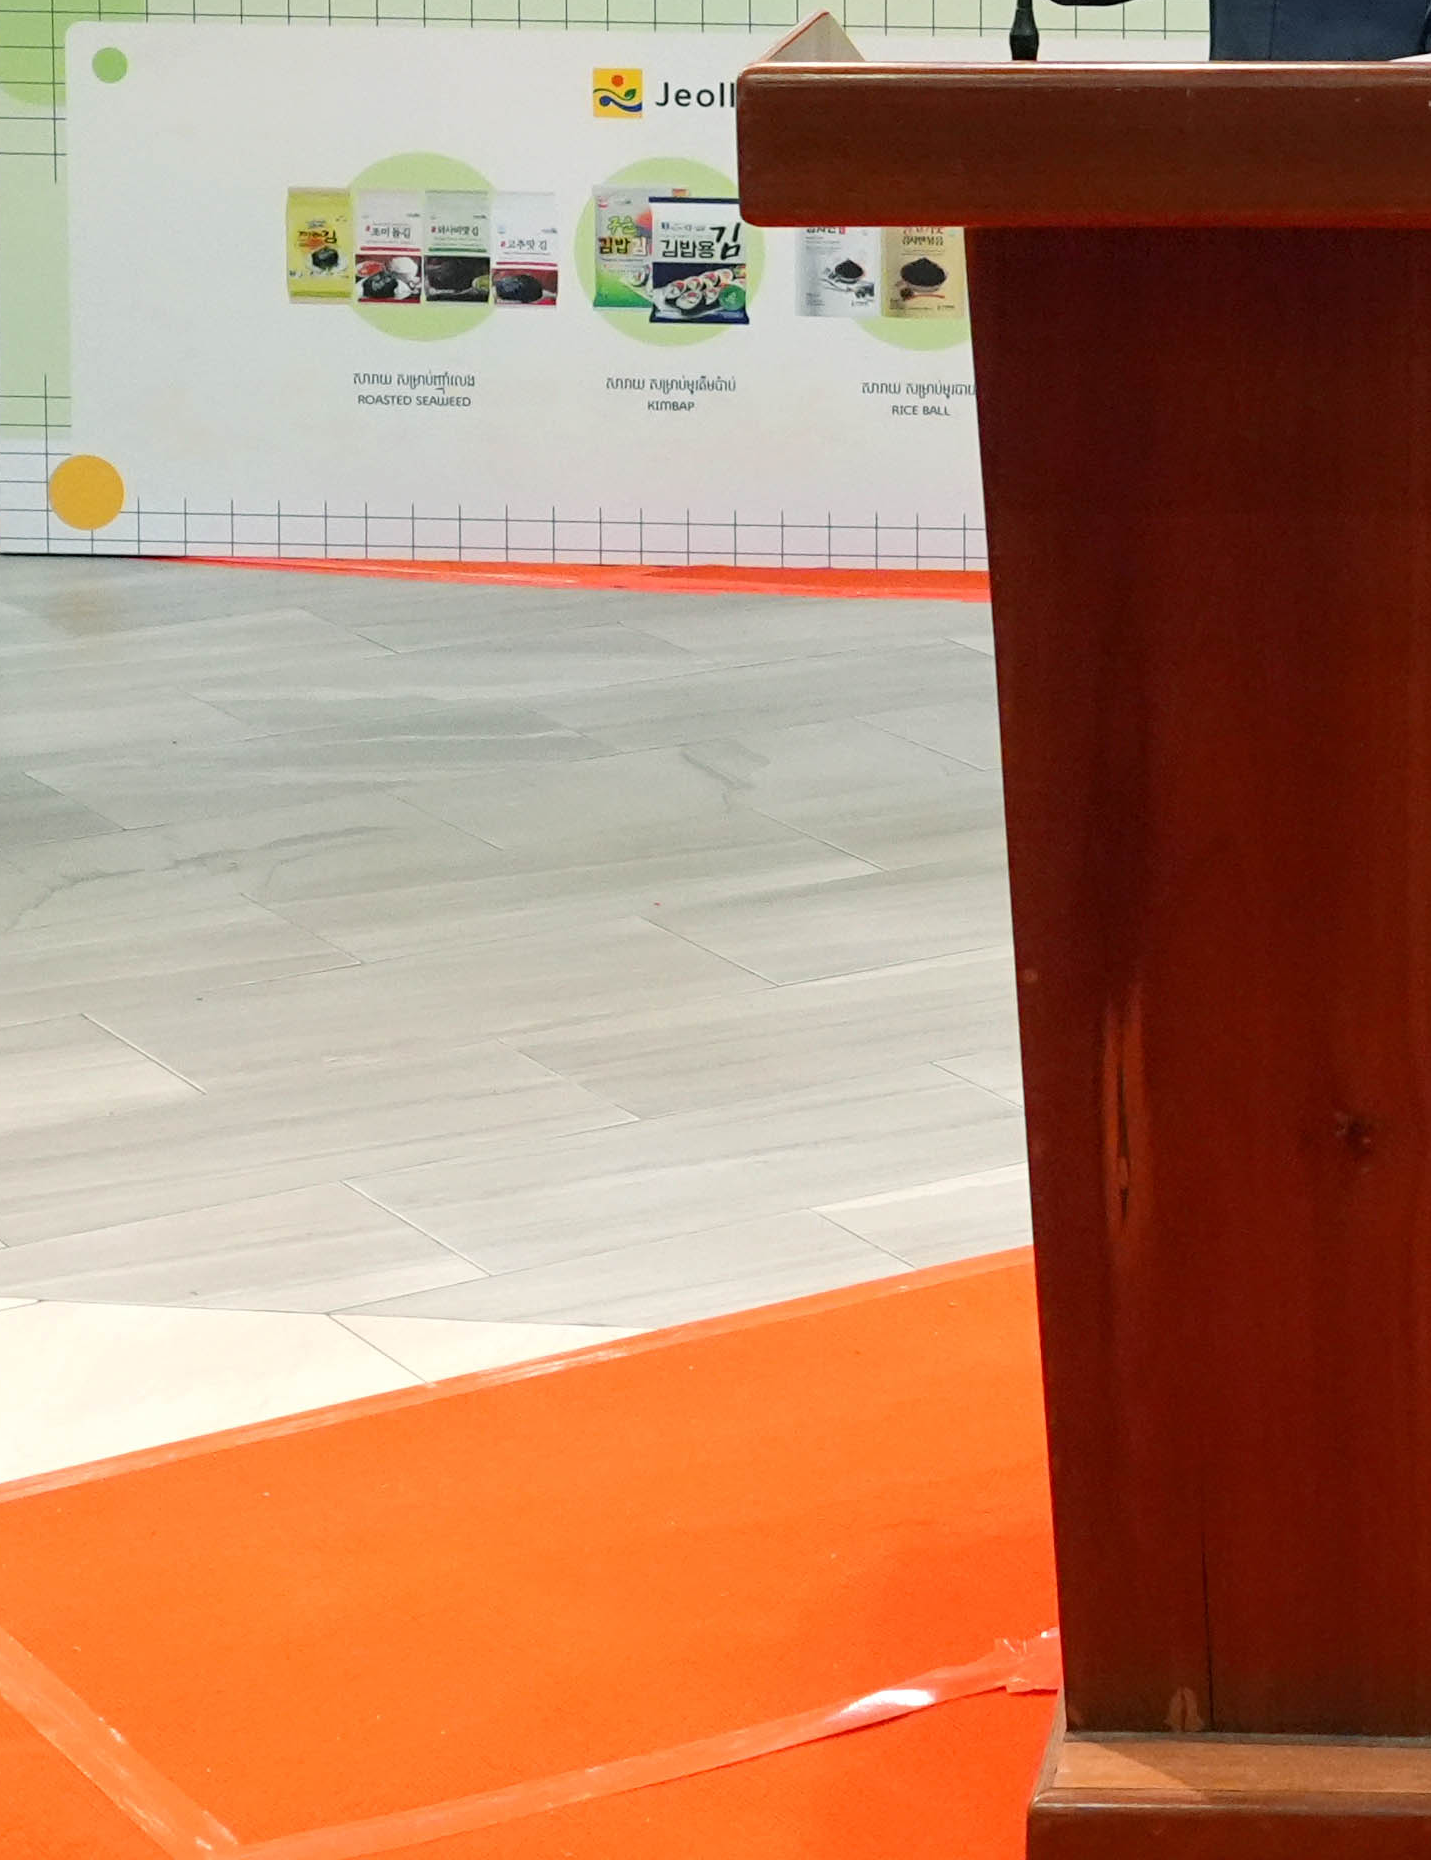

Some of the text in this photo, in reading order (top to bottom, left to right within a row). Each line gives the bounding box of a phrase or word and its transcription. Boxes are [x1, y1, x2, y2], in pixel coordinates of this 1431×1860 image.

[654, 81, 735, 109] Jeoll
[660, 221, 741, 261] 김밥용 김
[357, 394, 472, 408] ROASTED SEAWEED
[647, 400, 696, 412] KIMBAP
[891, 404, 952, 417] RICE BALL
